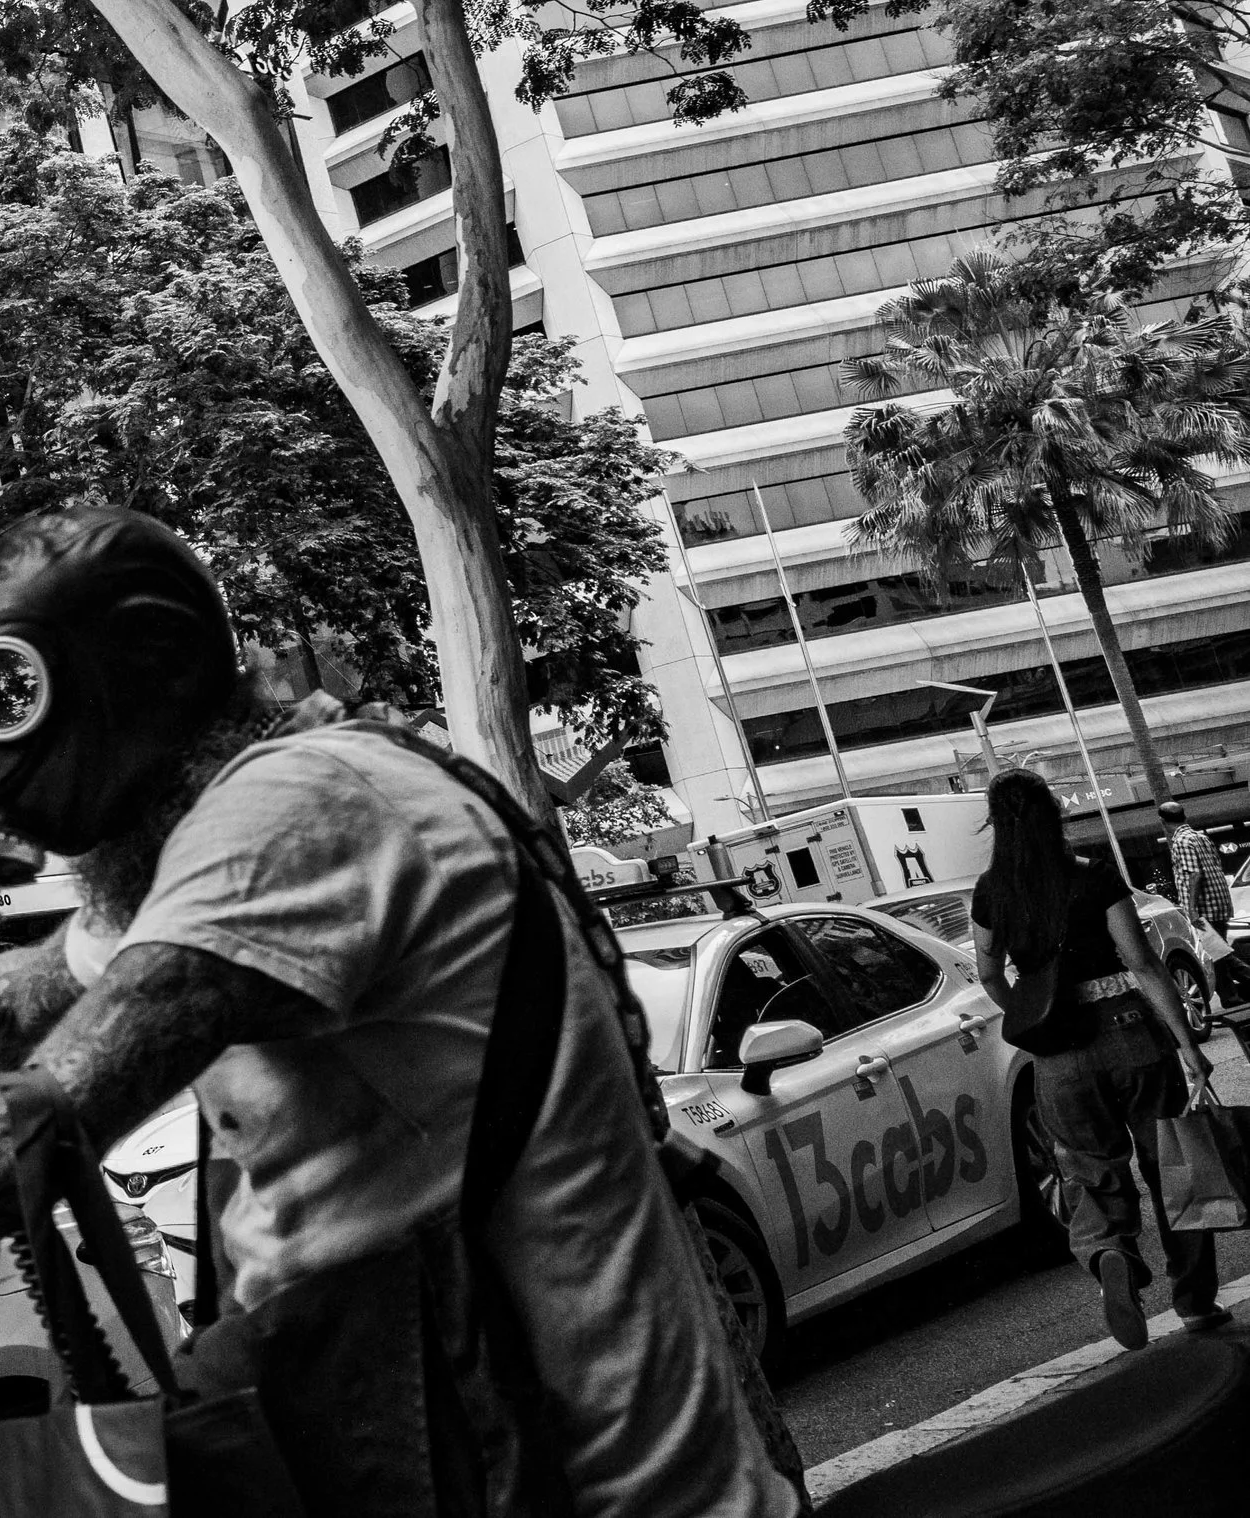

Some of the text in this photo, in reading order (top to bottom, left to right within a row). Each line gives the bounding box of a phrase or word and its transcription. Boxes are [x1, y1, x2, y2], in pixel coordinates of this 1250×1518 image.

[837, 844, 852, 852] VEHICLE
[841, 863, 856, 871] CAMERA
[681, 1101, 730, 1126] T58681
[764, 1075, 988, 1270] 13cabs
